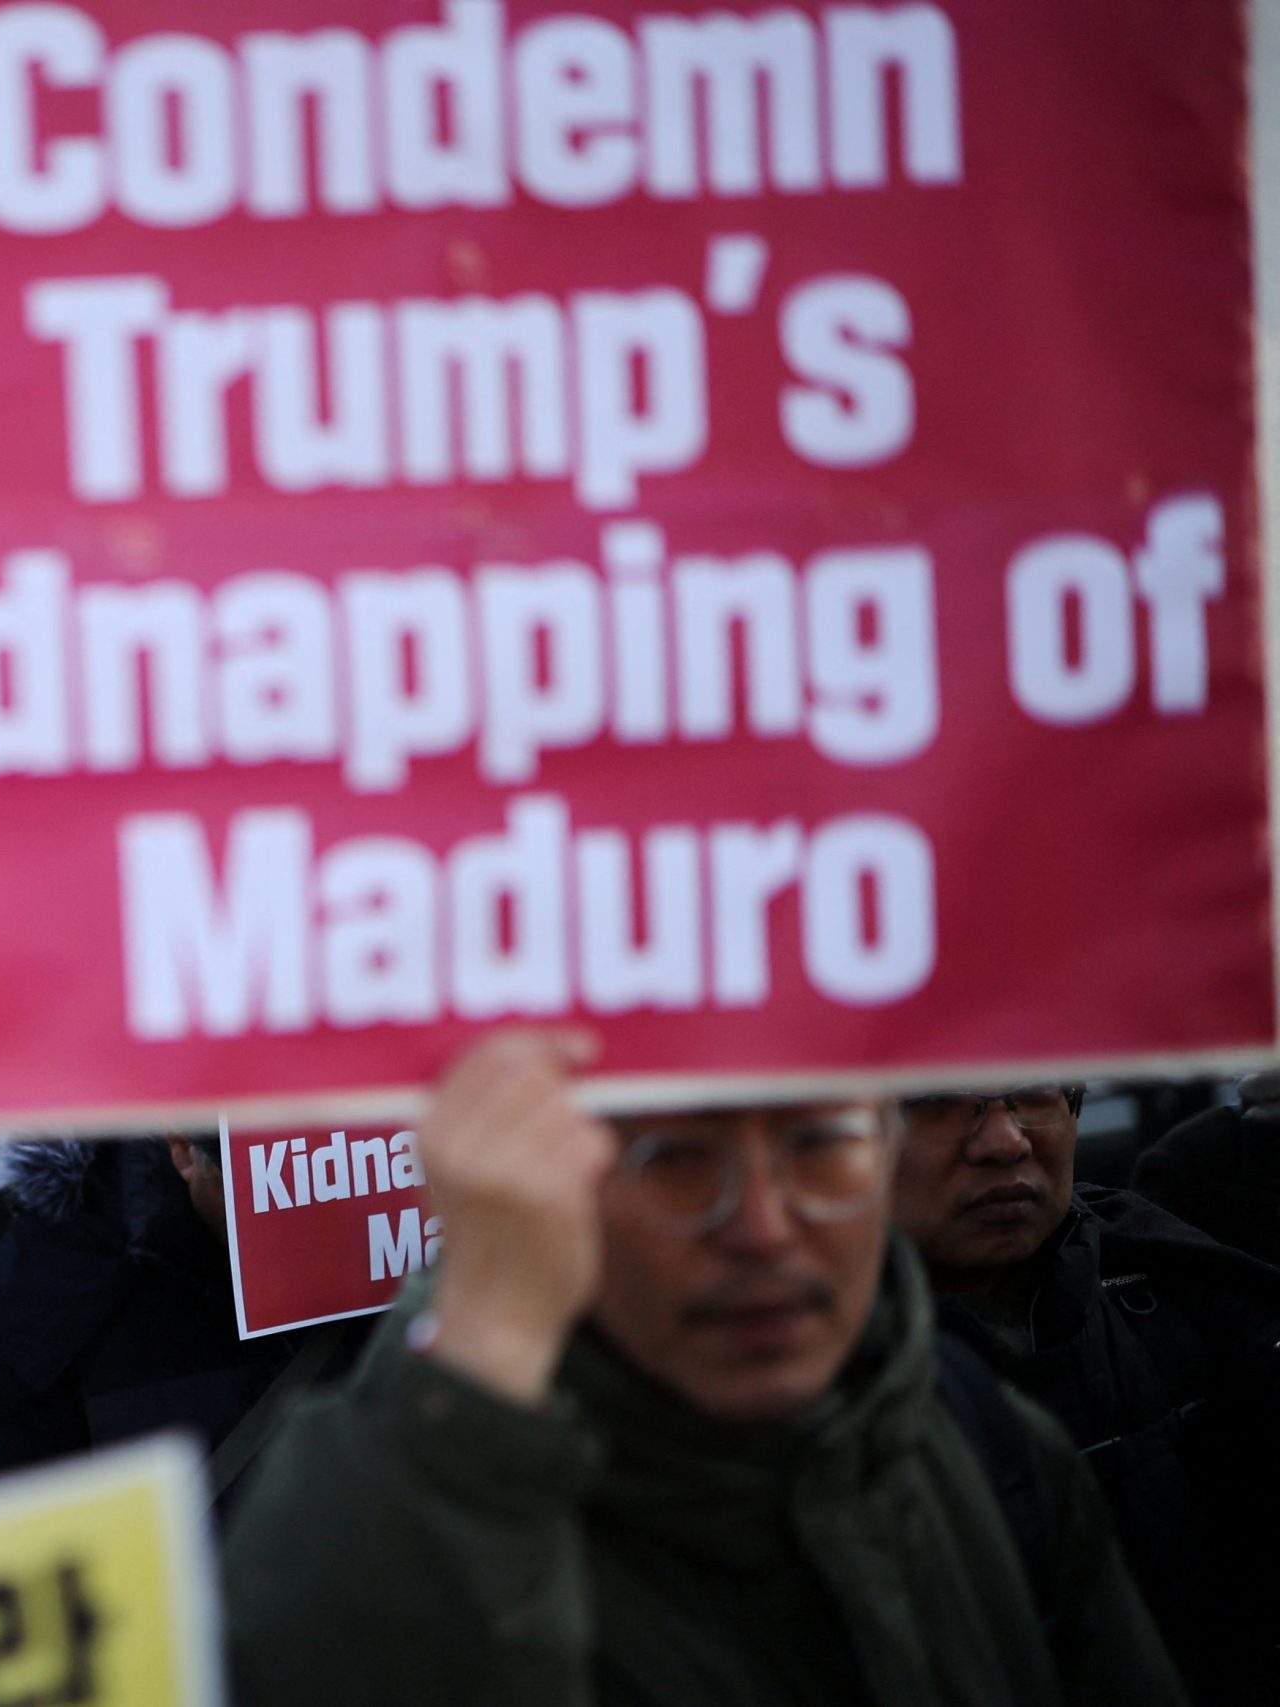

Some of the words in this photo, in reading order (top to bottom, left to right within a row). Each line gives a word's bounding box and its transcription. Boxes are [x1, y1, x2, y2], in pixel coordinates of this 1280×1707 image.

[24, 233, 916, 511] Trump's
[1005, 492, 1226, 727] of
[119, 791, 937, 1041] Maduro
